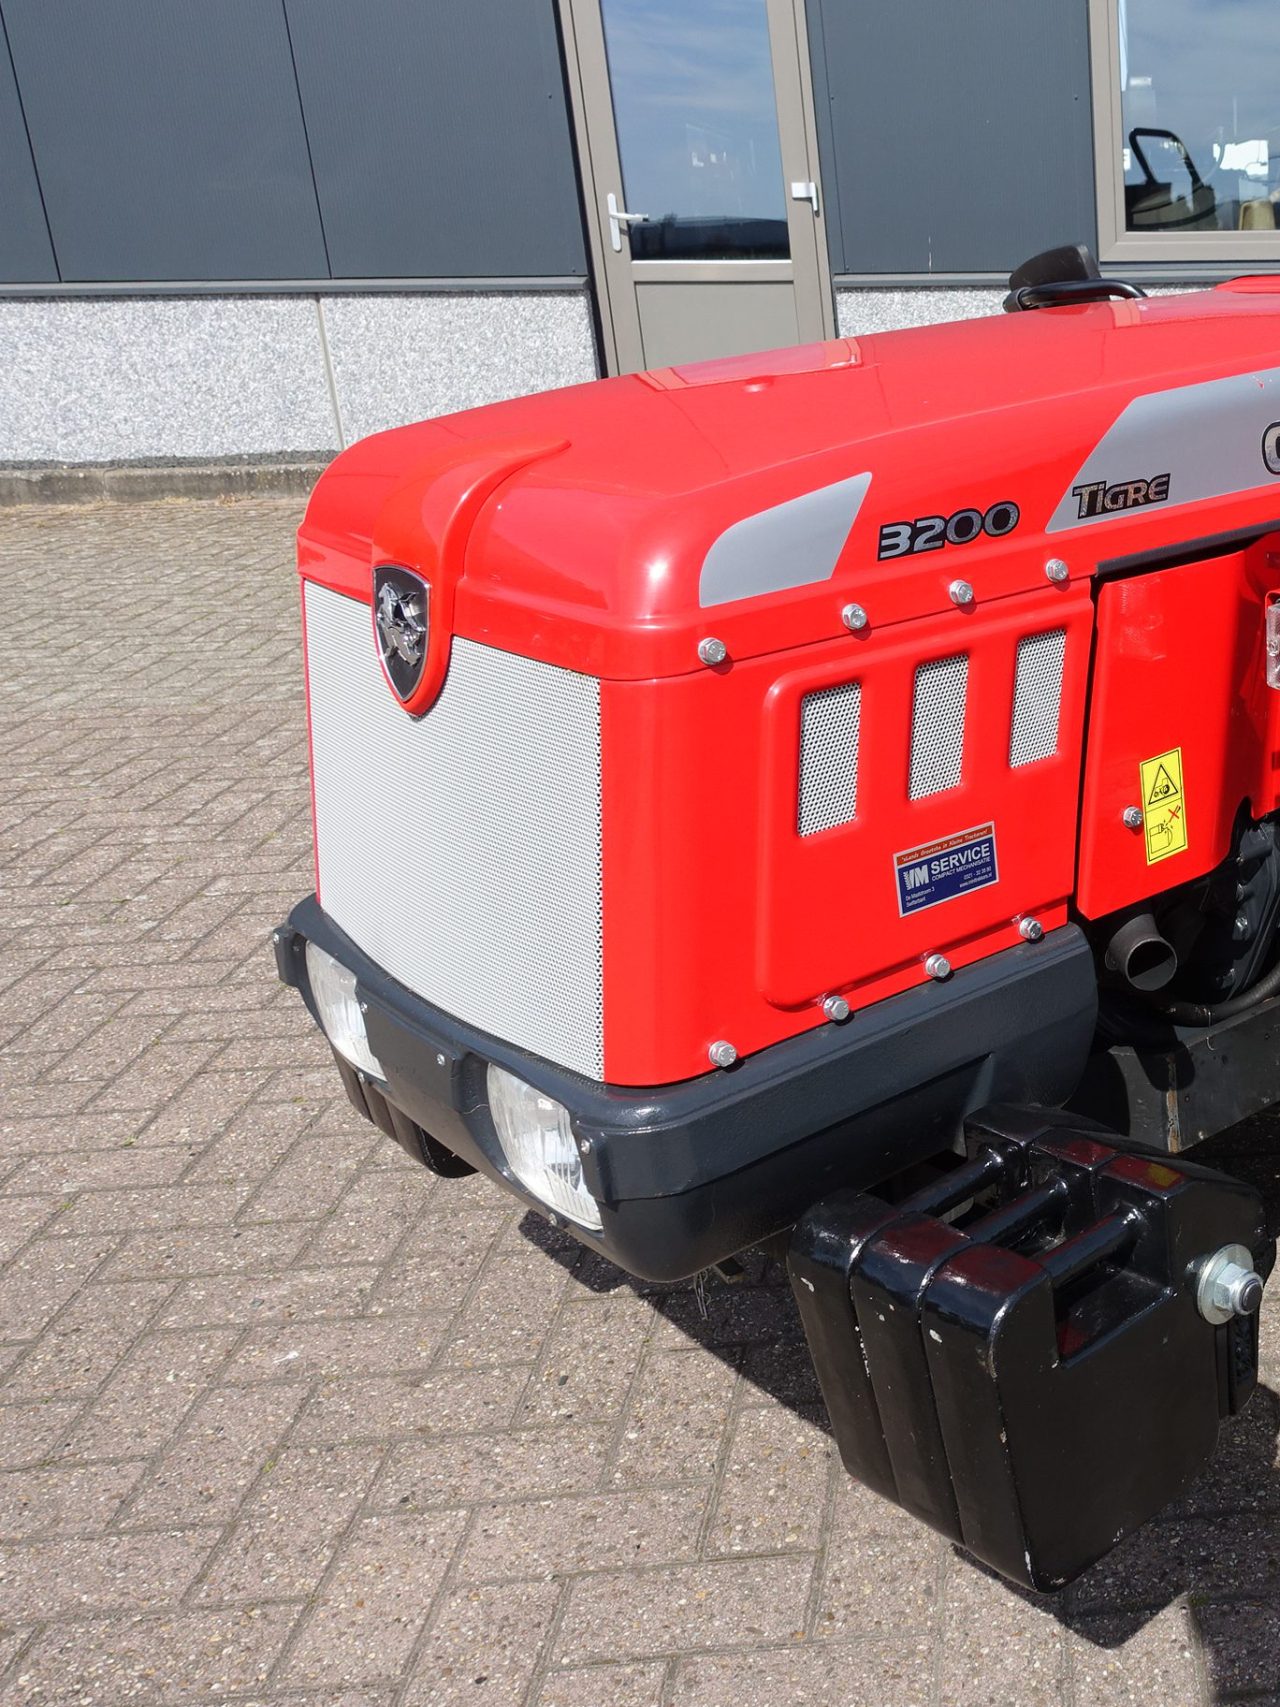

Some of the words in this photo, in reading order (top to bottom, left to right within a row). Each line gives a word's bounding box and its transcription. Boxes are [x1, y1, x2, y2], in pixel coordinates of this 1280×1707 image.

[879, 502, 1019, 560] 3200
[903, 864, 930, 891] VM
[930, 843, 991, 874] SERVICE
[931, 869, 956, 882] COMPACT
